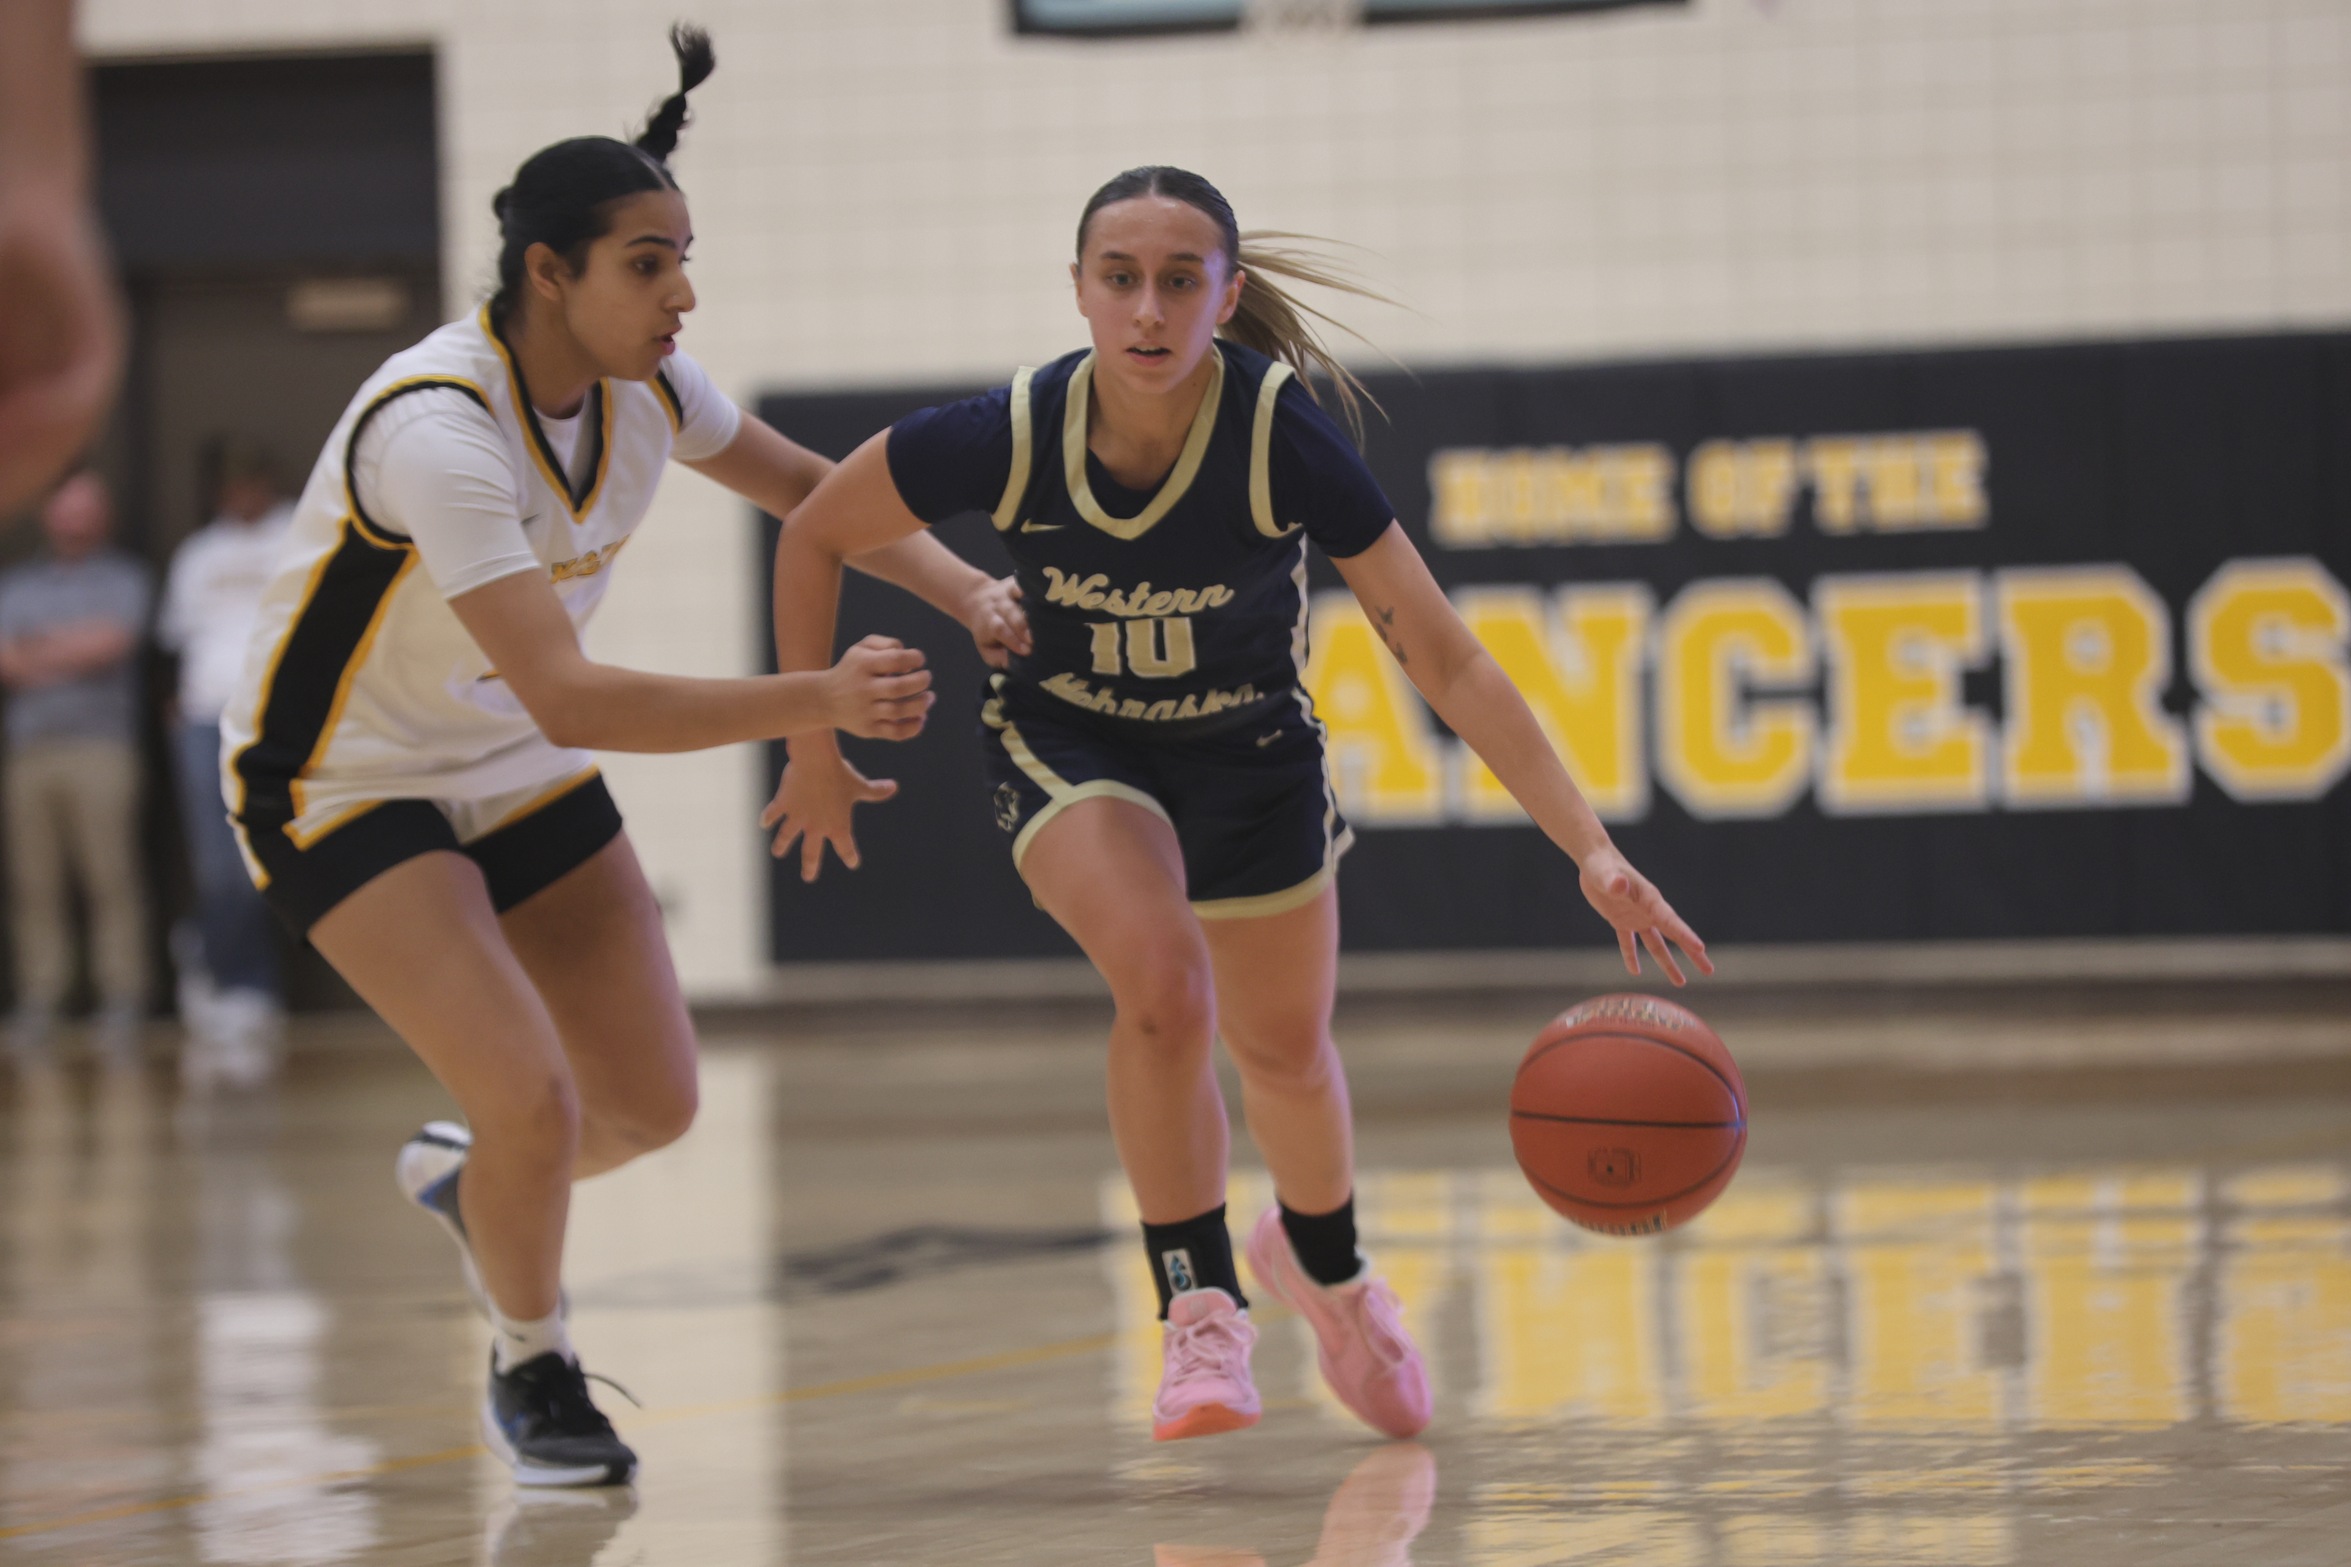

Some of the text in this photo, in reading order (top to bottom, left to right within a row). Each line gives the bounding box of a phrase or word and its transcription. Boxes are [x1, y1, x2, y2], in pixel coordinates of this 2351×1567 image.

[1431, 429, 1989, 547] HOME OF THE
[1042, 565, 1235, 617] Western
[1084, 616, 1197, 678] 10
[1303, 560, 2351, 828] ANCERS
